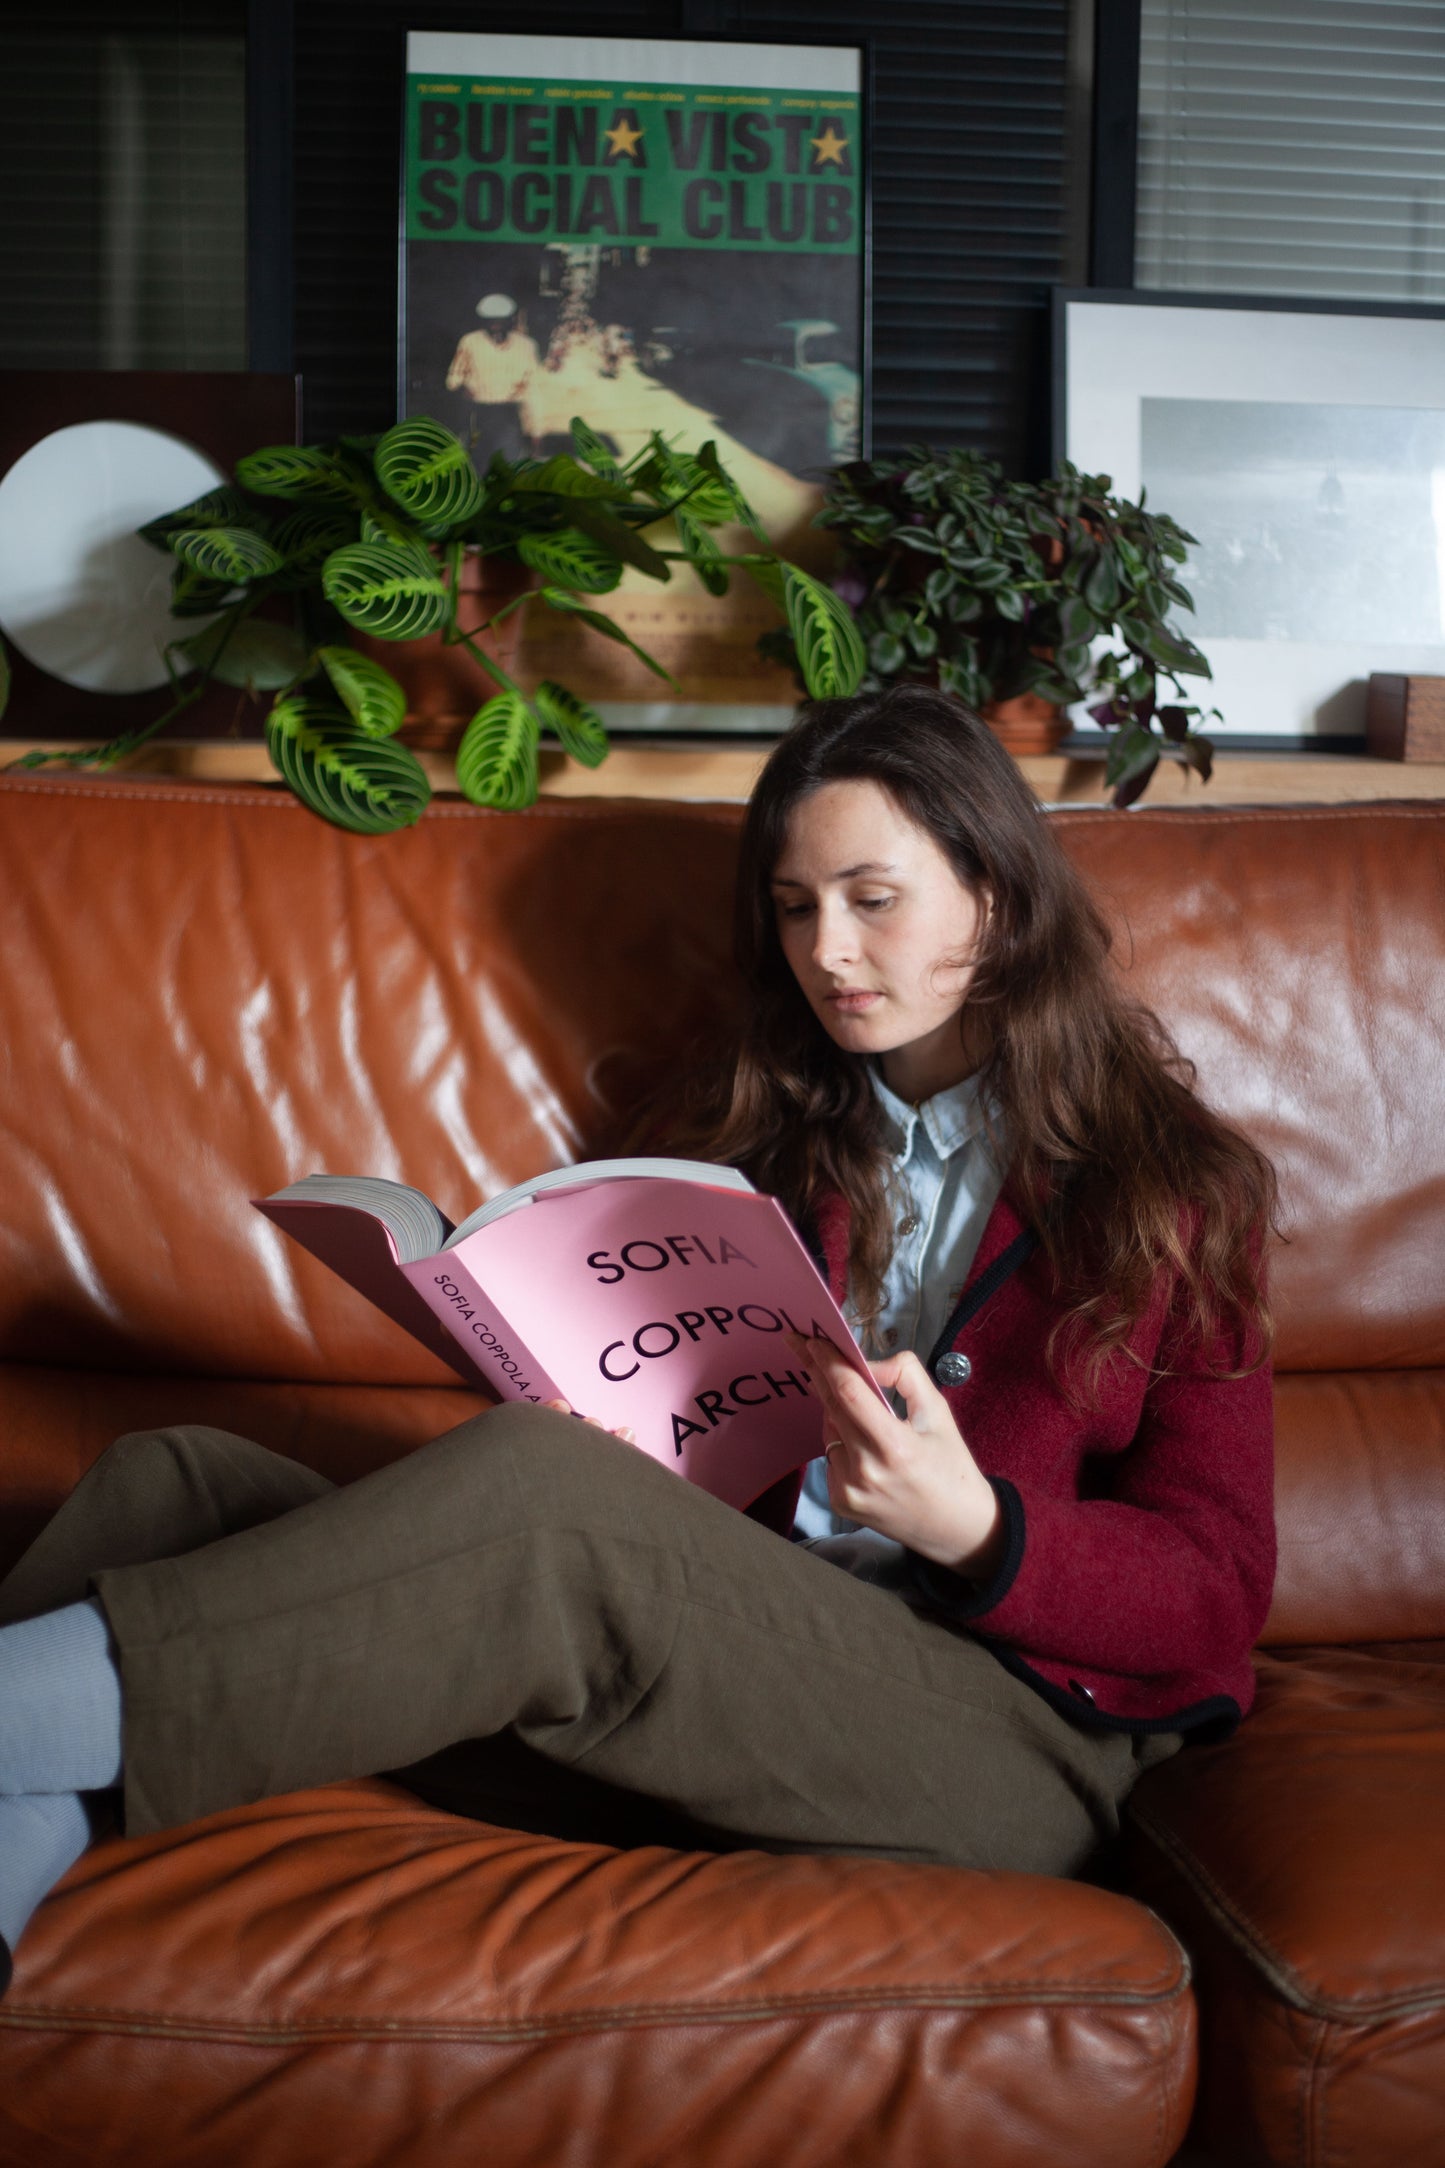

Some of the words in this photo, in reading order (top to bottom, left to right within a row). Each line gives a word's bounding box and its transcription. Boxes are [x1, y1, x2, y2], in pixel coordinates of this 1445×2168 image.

[418, 101, 648, 169] BUENA
[665, 108, 854, 176] VISTA
[418, 168, 659, 237] SOCIAL
[683, 177, 855, 244] CLUB
[586, 1234, 759, 1284] SOFIA
[434, 1274, 475, 1320] SOFIA
[472, 1322, 530, 1392] COPPOLA
[598, 1304, 834, 1382] COPPOLA
